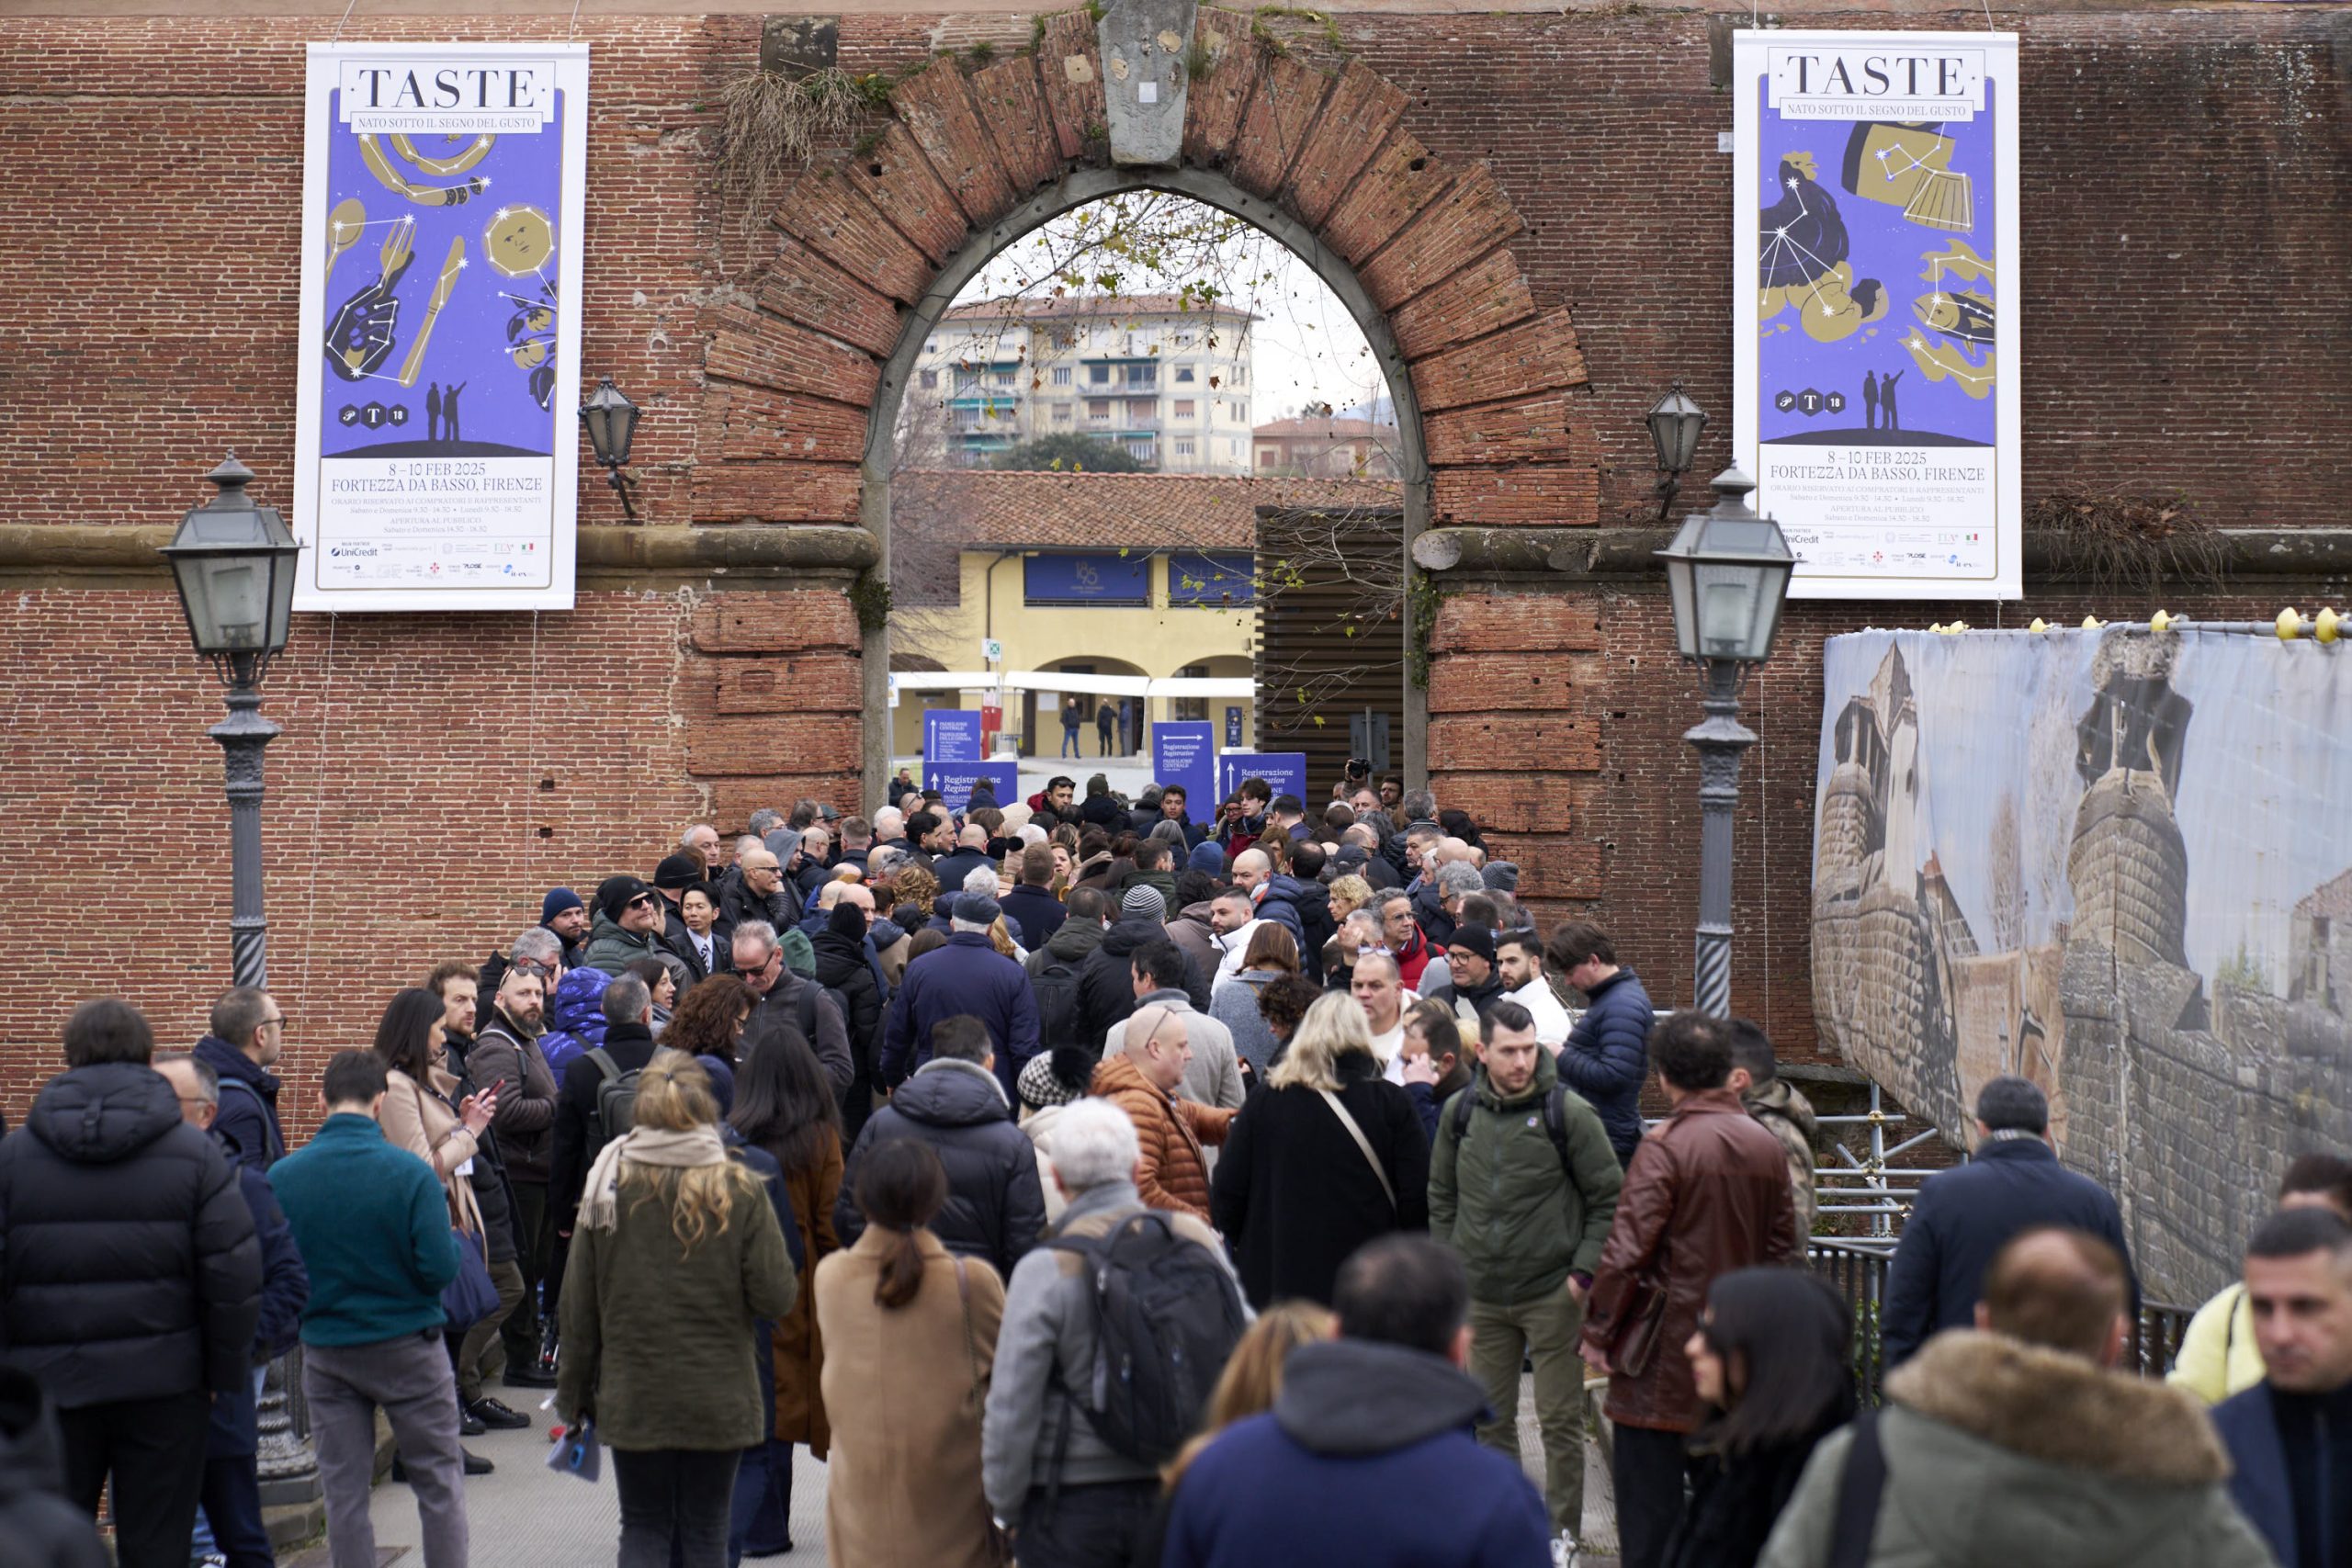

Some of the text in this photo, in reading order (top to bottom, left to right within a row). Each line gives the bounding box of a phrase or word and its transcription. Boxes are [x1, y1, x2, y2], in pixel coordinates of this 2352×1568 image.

[1787, 56, 1964, 96] TASTE
[359, 69, 535, 108] TASTE
[1788, 104, 1966, 117] NATO SOTTO IL SEGNO DEL GUSTO
[358, 118, 535, 129] NATO SOTTO IL SEGNO DEL GUSTO
[1804, 395, 1816, 410] T
[1830, 398, 1840, 407] 18
[368, 408, 380, 423] T
[393, 411, 403, 420] 18
[1827, 451, 1835, 463] 8
[1849, 451, 1861, 464] 10
[1866, 451, 1892, 464] FEB
[1894, 452, 1927, 465] 2025
[389, 463, 396, 475] 8
[410, 463, 422, 475] 10
[426, 463, 451, 475] FEB
[455, 462, 486, 475] 2025
[1770, 465, 1984, 481] FORTEZZA DA BASSO, FIRENZE
[332, 478, 542, 492] FORTEZZA DA BASSO, FIRENZE
[341, 547, 378, 557] UniCredit
[1241, 768, 1294, 778] Registrazione
